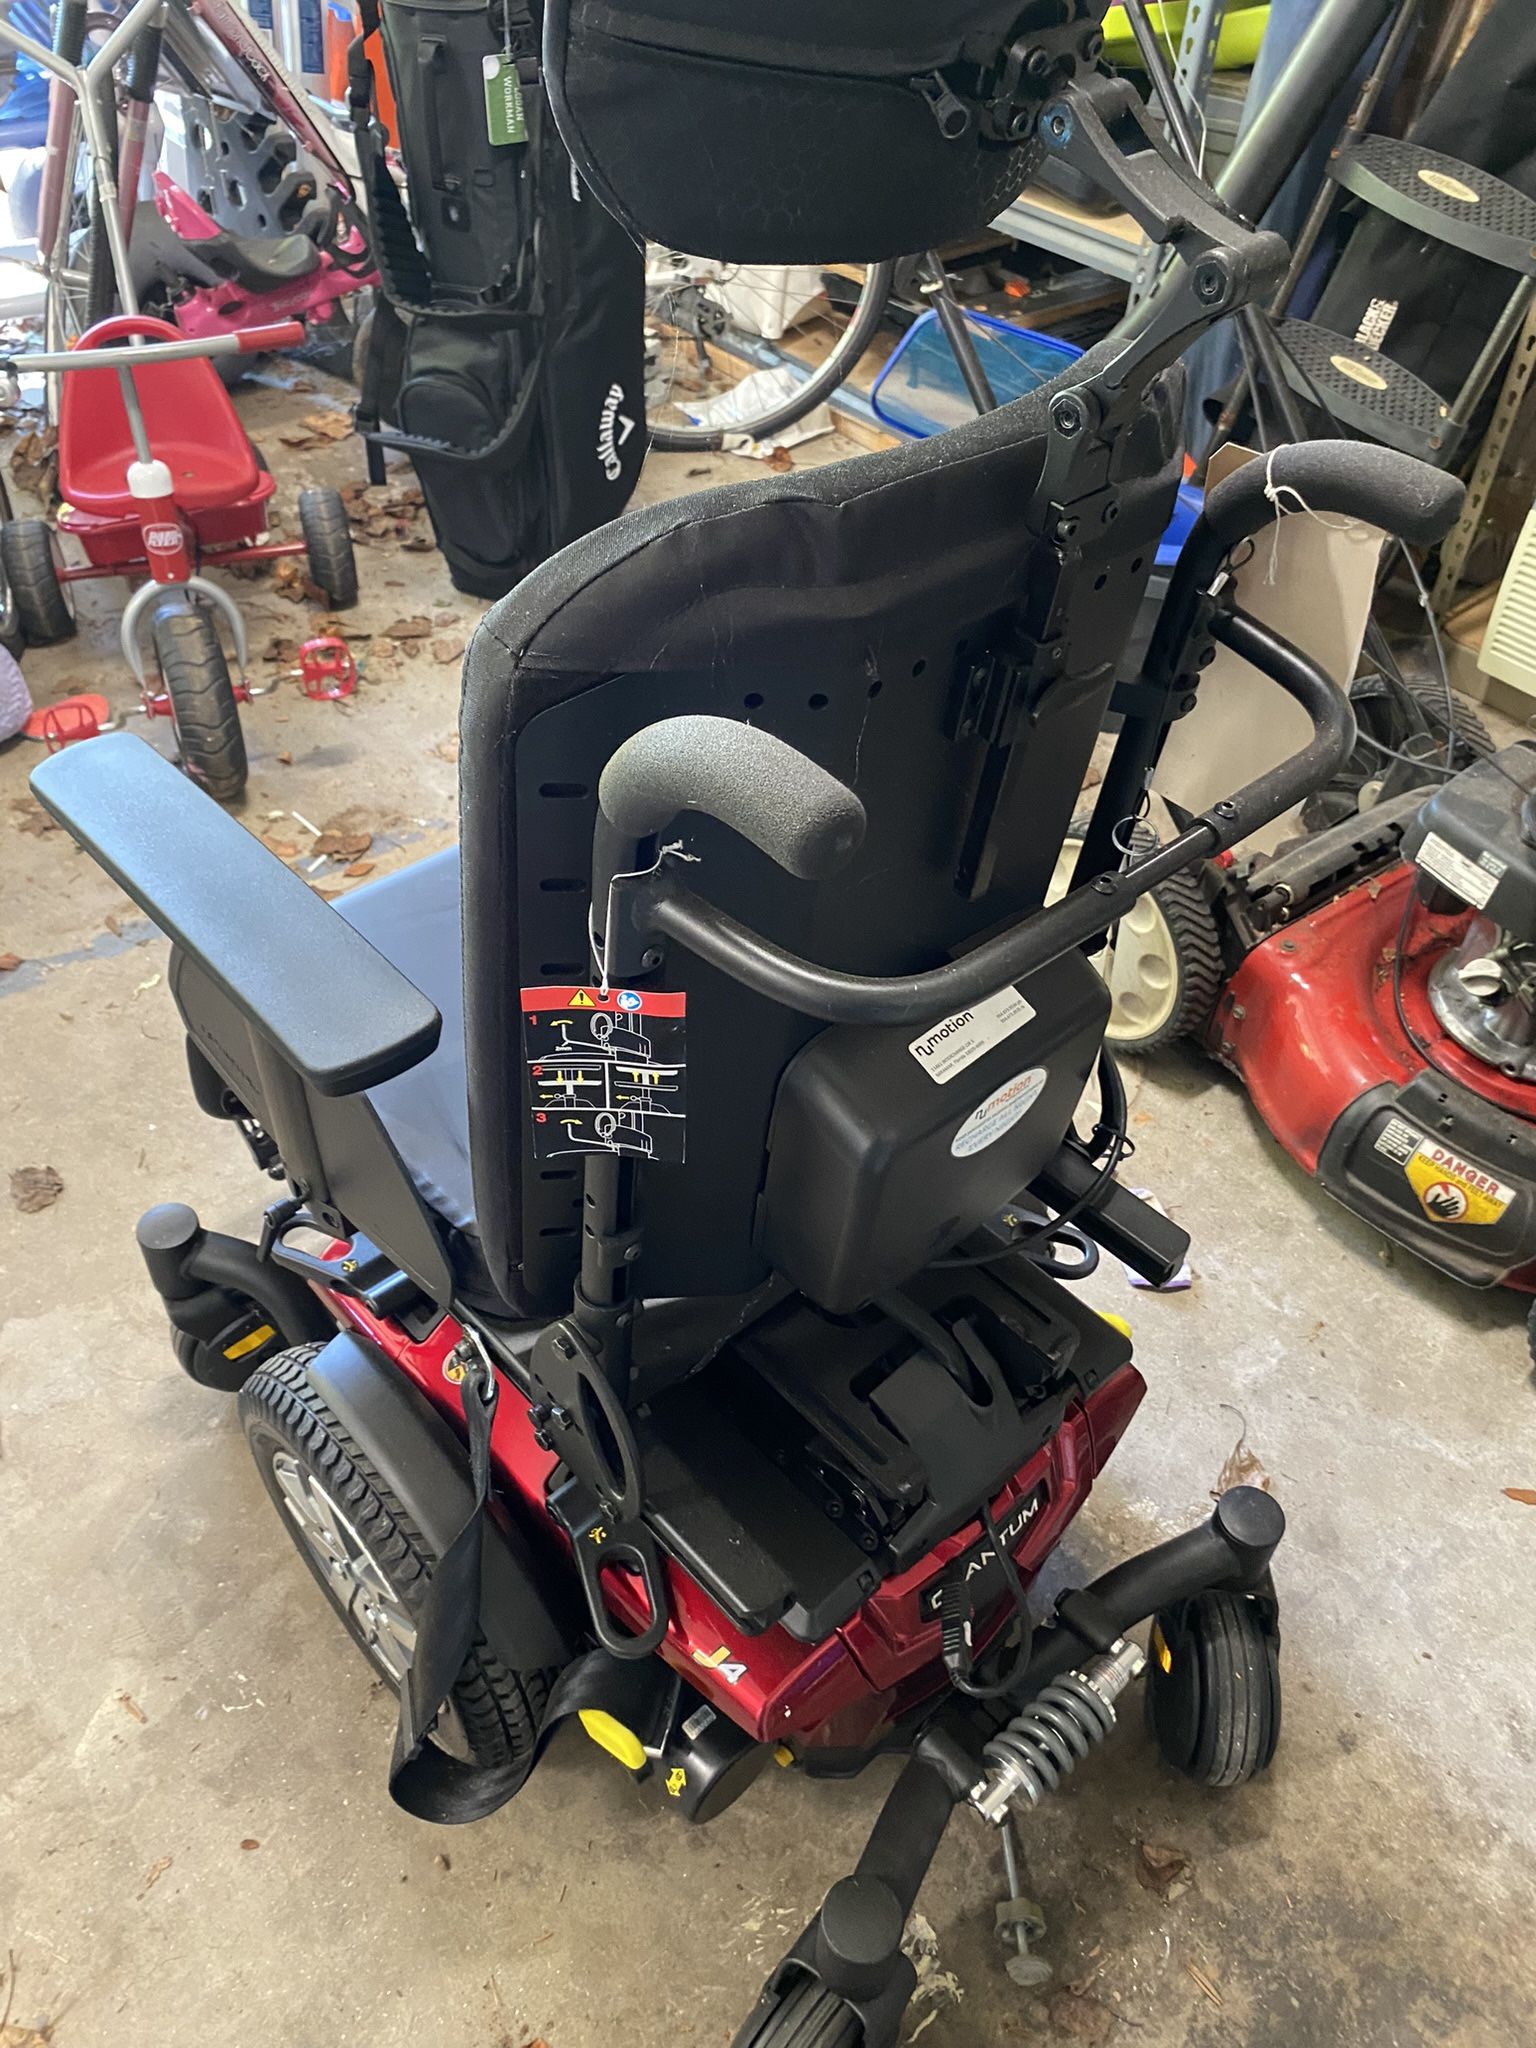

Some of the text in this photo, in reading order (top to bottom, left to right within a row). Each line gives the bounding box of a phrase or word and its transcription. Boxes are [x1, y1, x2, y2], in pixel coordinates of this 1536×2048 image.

[503, 75, 516, 134] WORKMAN
[596, 384, 624, 480] Callaway
[529, 1015, 537, 1025] 1
[914, 1009, 974, 1057] numotion
[532, 1065, 543, 1076] 2
[535, 1113, 547, 1123] 3
[1431, 1148, 1499, 1196] DANGER
